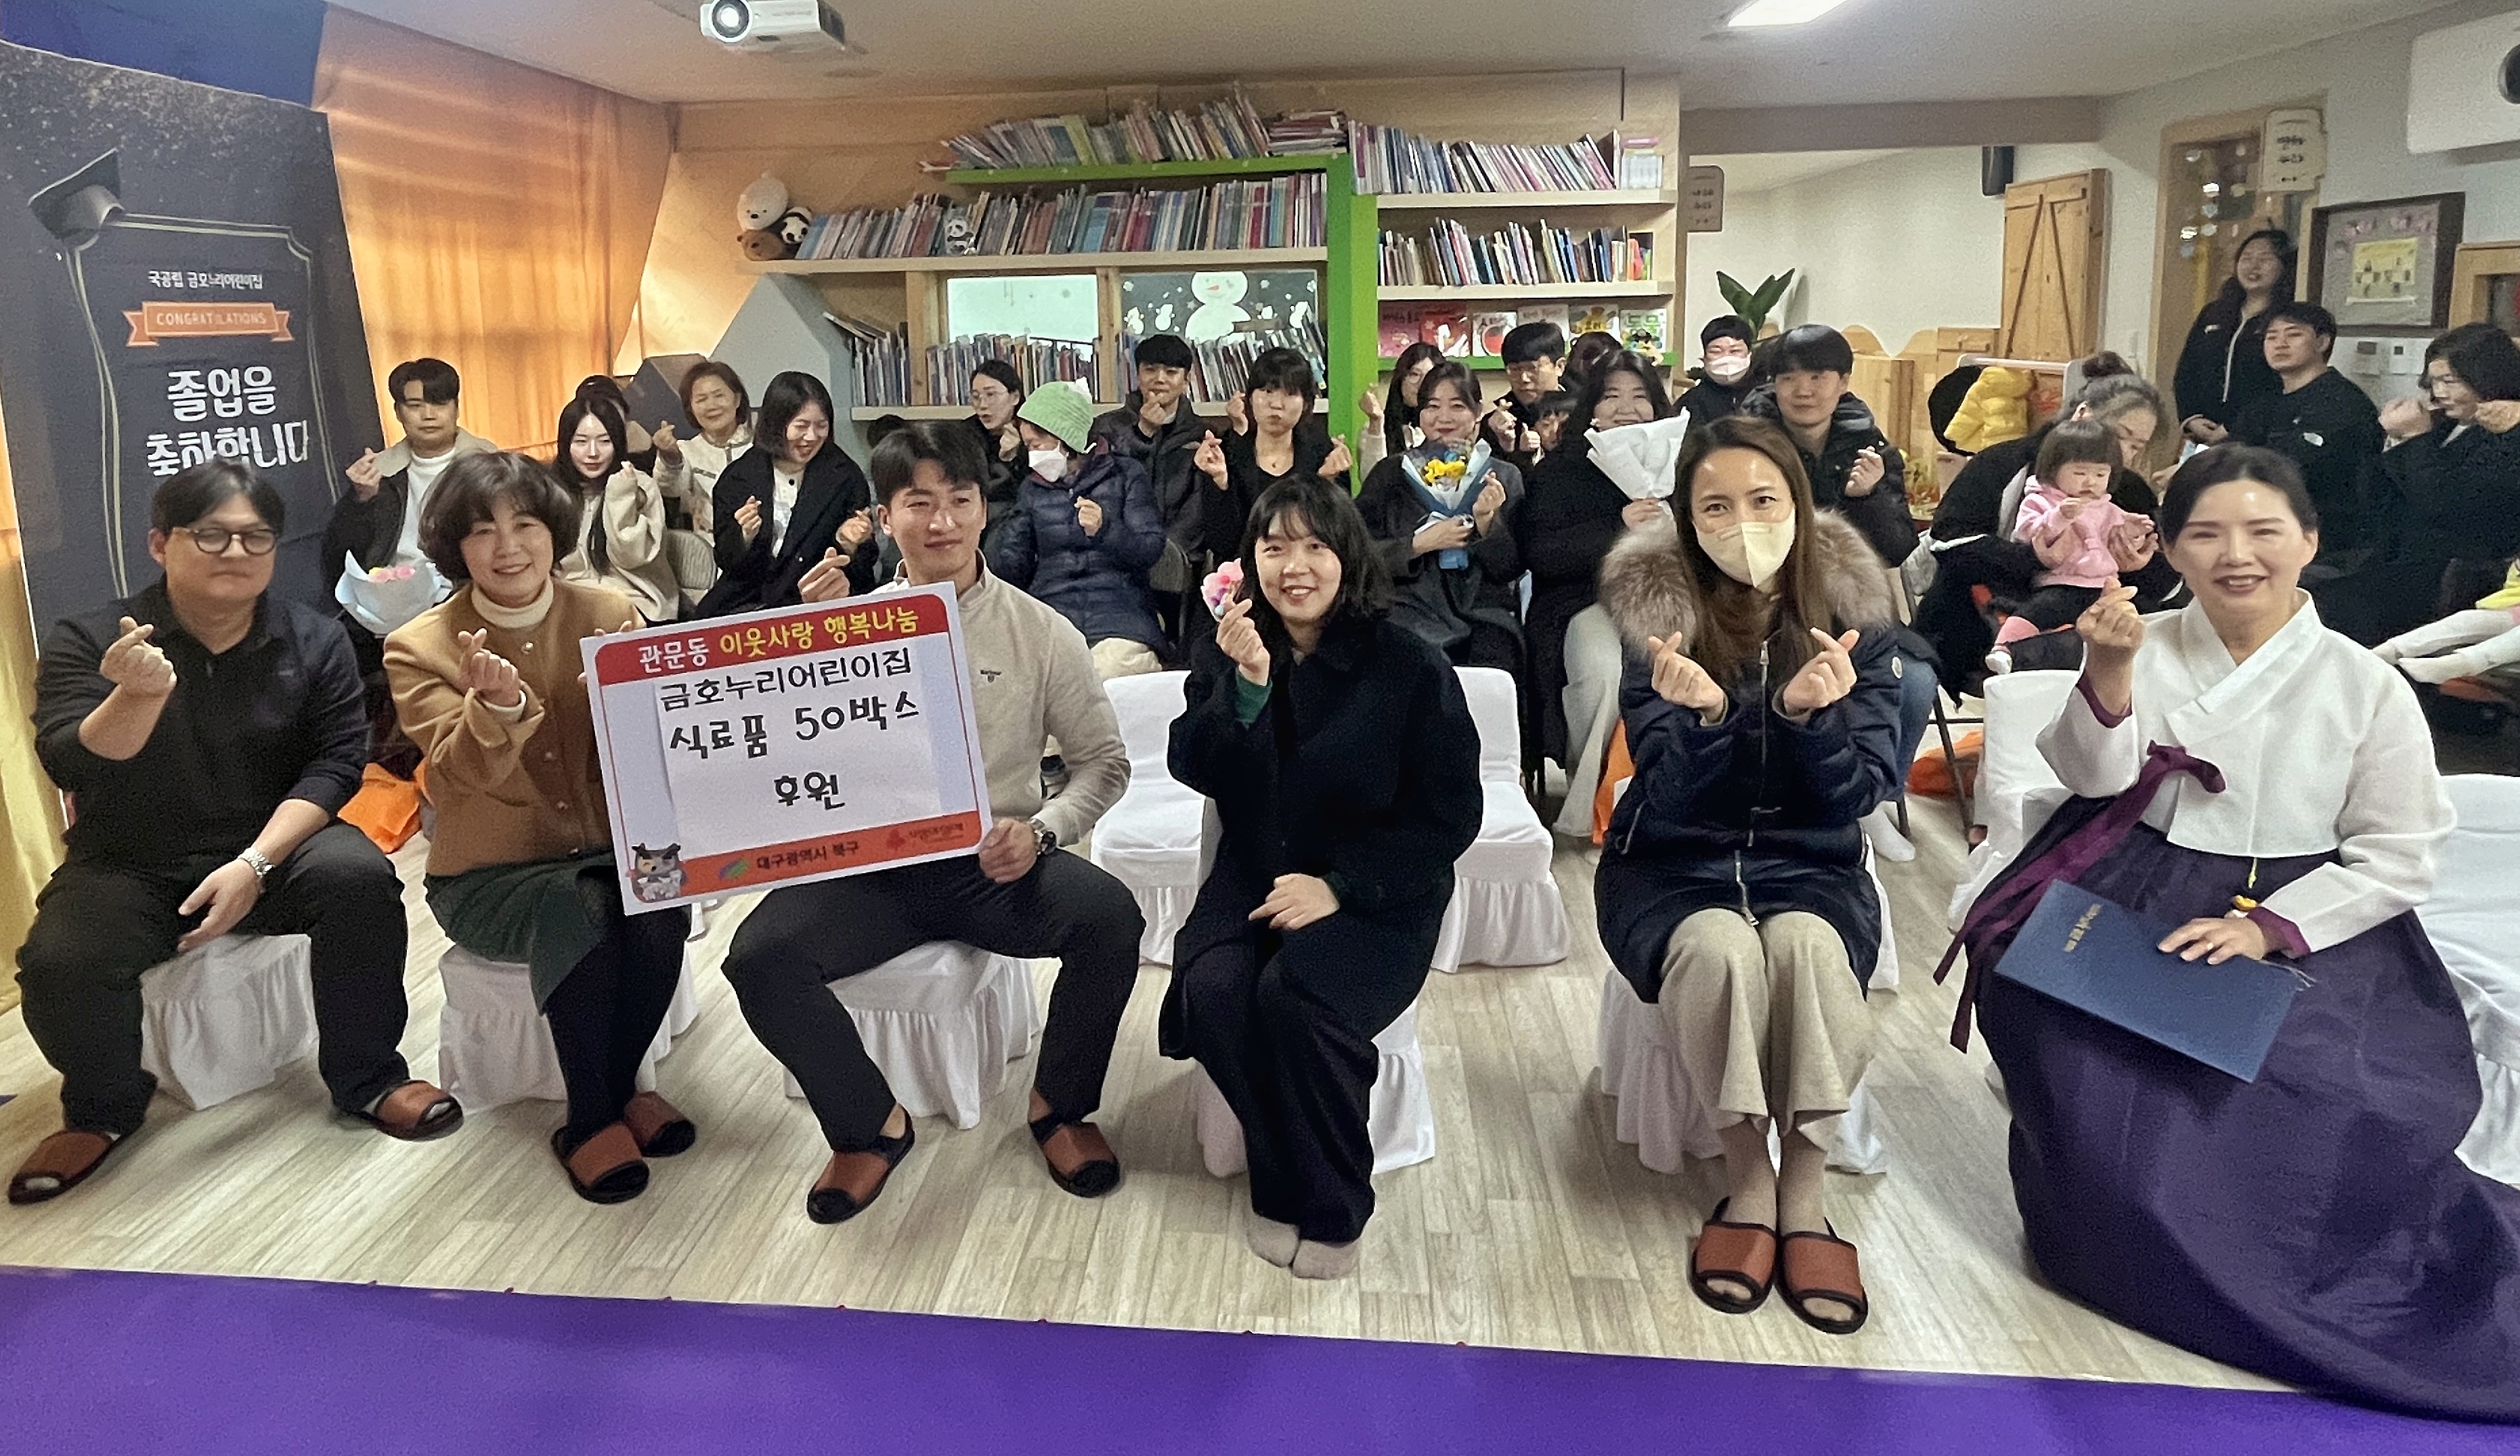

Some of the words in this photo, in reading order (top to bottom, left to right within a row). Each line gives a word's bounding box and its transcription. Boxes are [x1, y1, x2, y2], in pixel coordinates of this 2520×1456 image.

[148, 271, 183, 288] 국공립
[167, 366, 276, 422] 졸업을
[146, 420, 309, 477] 축하합니다
[638, 637, 710, 674] 관문동
[720, 621, 814, 658] 이웃사랑
[823, 605, 919, 644] 행복나눔
[659, 647, 912, 712] 금호누리어린이집
[670, 714, 768, 759] 식료품
[795, 690, 919, 741] 50박스
[774, 771, 846, 810] 후원
[756, 845, 827, 870] 대구광역시
[832, 841, 859, 858] 북구
